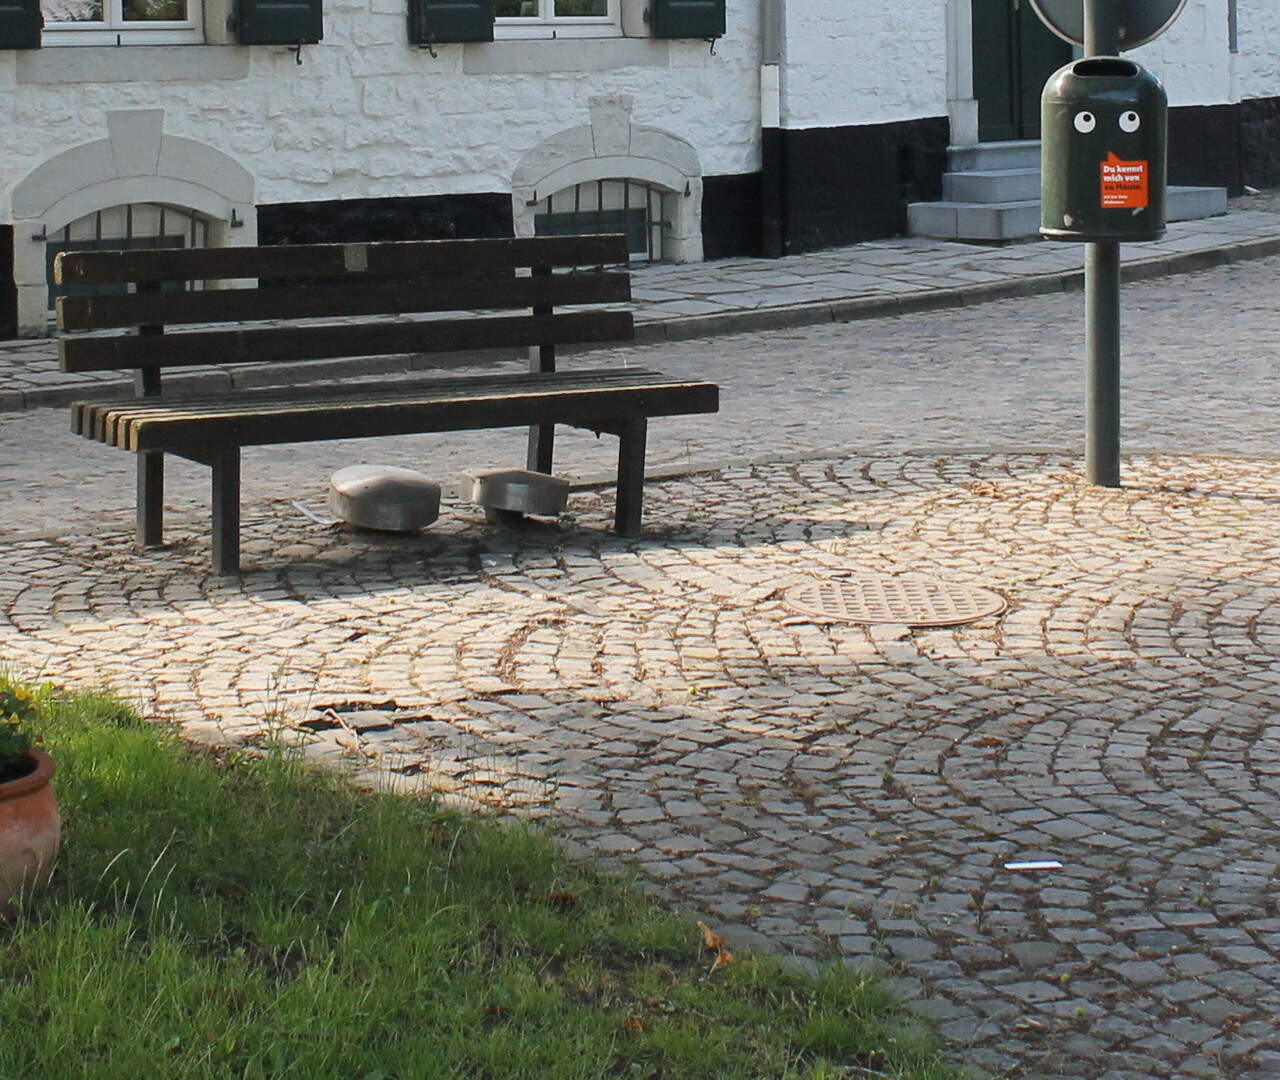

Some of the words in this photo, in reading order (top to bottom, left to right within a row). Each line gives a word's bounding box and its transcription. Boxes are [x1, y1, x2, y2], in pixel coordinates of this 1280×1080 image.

[1103, 165, 1115, 173] Du
[1116, 165, 1143, 173] kennst
[1103, 174, 1123, 182] mich
